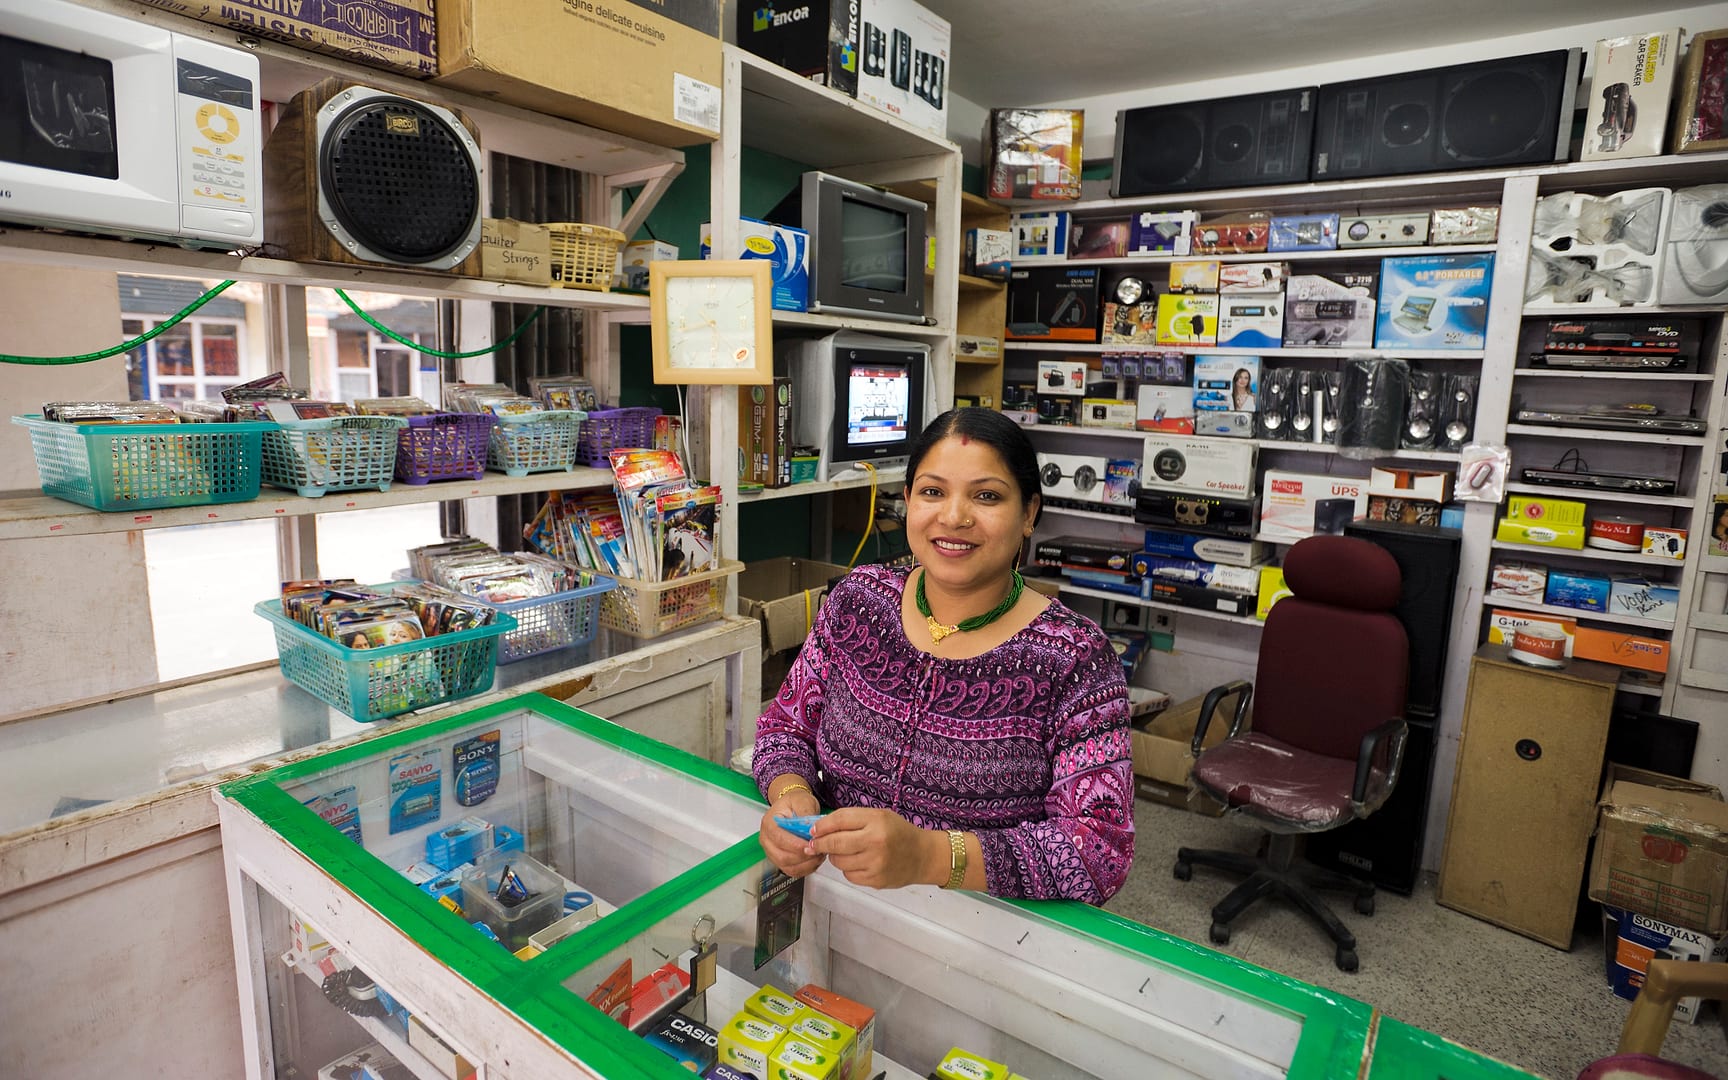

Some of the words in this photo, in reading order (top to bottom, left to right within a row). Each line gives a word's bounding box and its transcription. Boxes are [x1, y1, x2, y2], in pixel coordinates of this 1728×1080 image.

[221, 5, 313, 42] SYSTEM
[595, 4, 633, 29] delicate
[634, 21, 666, 42] cuisine
[848, 0, 858, 44] ENCO
[362, 39, 379, 51] AND
[380, 45, 400, 56] LOUD
[1637, 38, 1647, 54] CAR
[1632, 53, 1645, 87] SPEAKER
[1434, 267, 1486, 280] PORTABLE
[1656, 330, 1679, 338] DVD
[341, 417, 371, 430] HINDI
[1206, 480, 1217, 488] Car
[1218, 481, 1246, 492] Speaker
[1331, 486, 1359, 497] UPS
[1498, 571, 1530, 583] Anylight
[1516, 635, 1537, 648] India's
[457, 744, 495, 764] SONY
[400, 764, 433, 780] SANYO
[470, 765, 493, 777] SONY
[470, 789, 494, 801] SONY
[319, 802, 348, 820] ANYO
[1634, 914, 1703, 946] SONYMAX
[670, 1018, 719, 1048] CASIO
